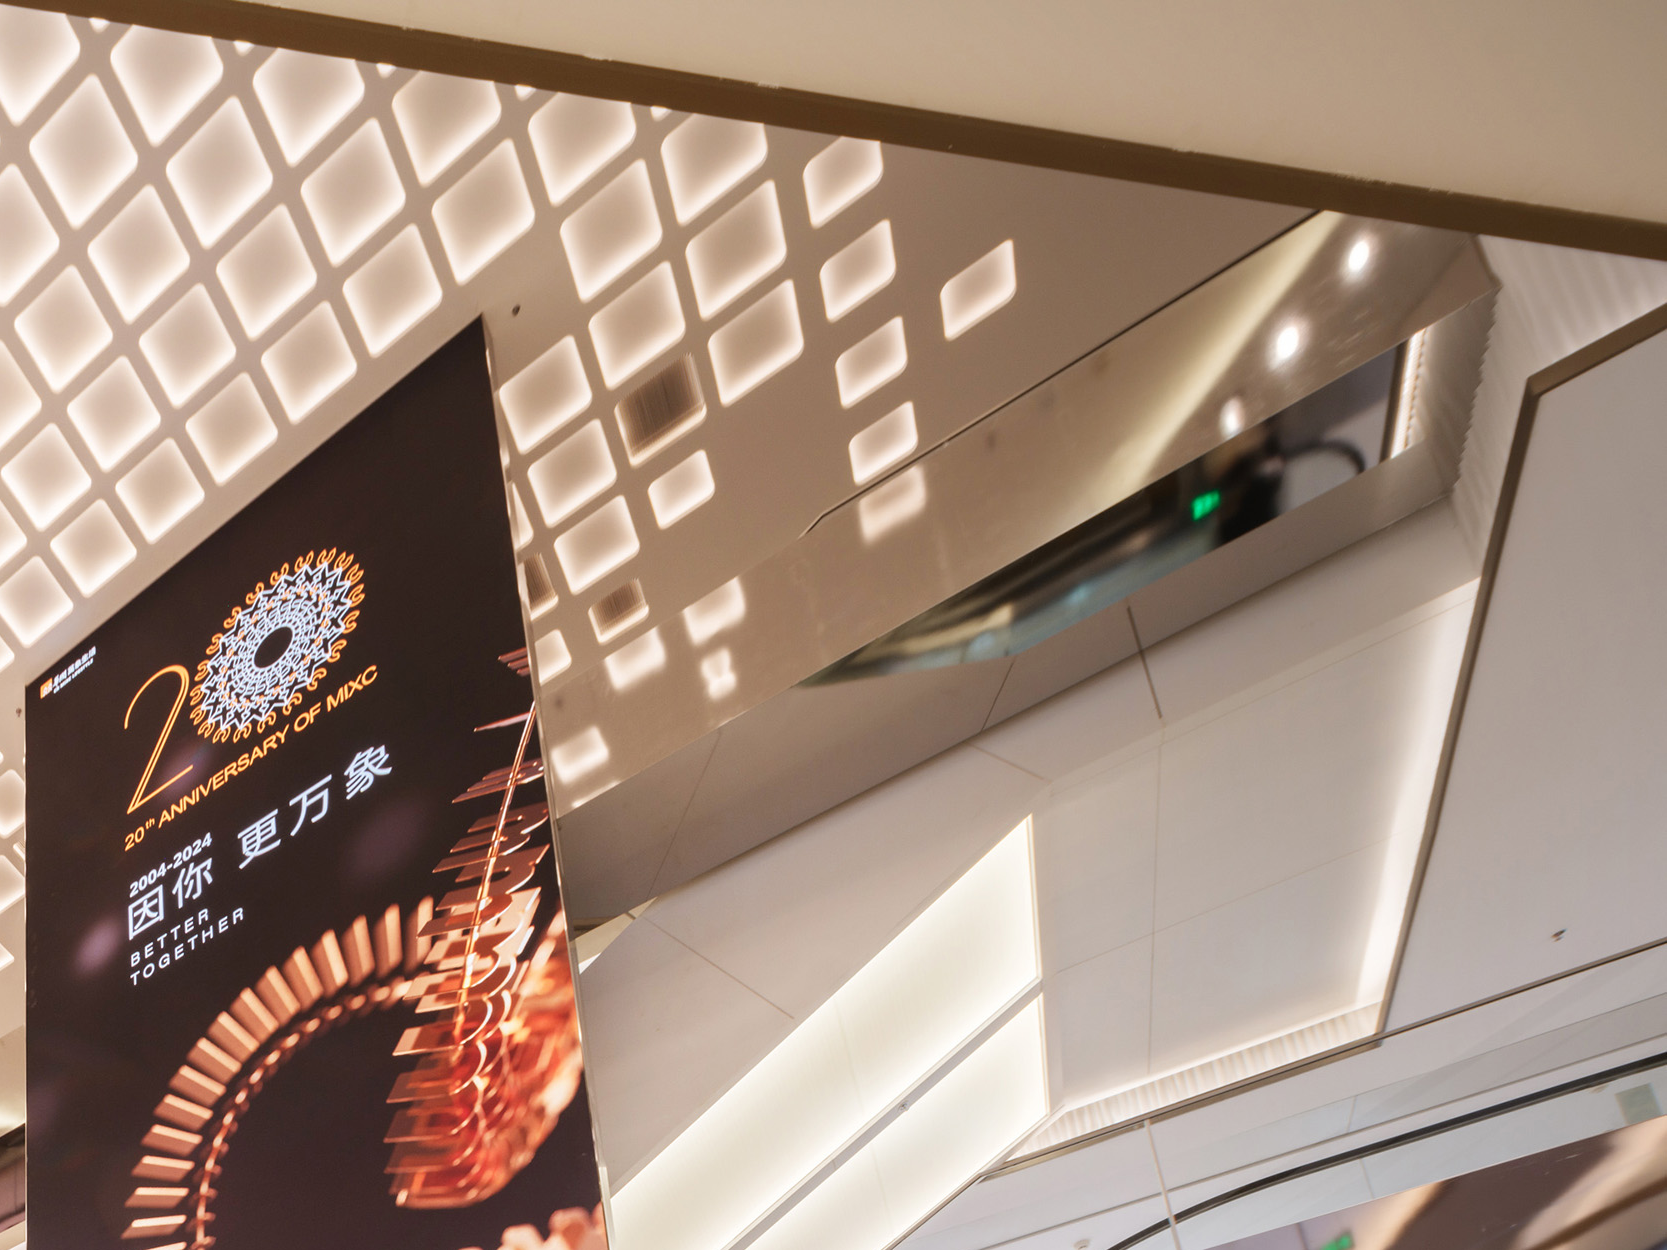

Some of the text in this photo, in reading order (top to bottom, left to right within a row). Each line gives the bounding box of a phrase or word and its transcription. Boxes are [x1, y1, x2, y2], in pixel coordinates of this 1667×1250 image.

[158, 724, 290, 829] ANNIVERSARY
[293, 702, 322, 733] OF
[326, 664, 379, 713] MIXC
[128, 744, 394, 941] 因你 更万象
[128, 831, 213, 898] 2004-2024
[129, 906, 245, 987] TOGETHER
[130, 907, 210, 968] BETTER
